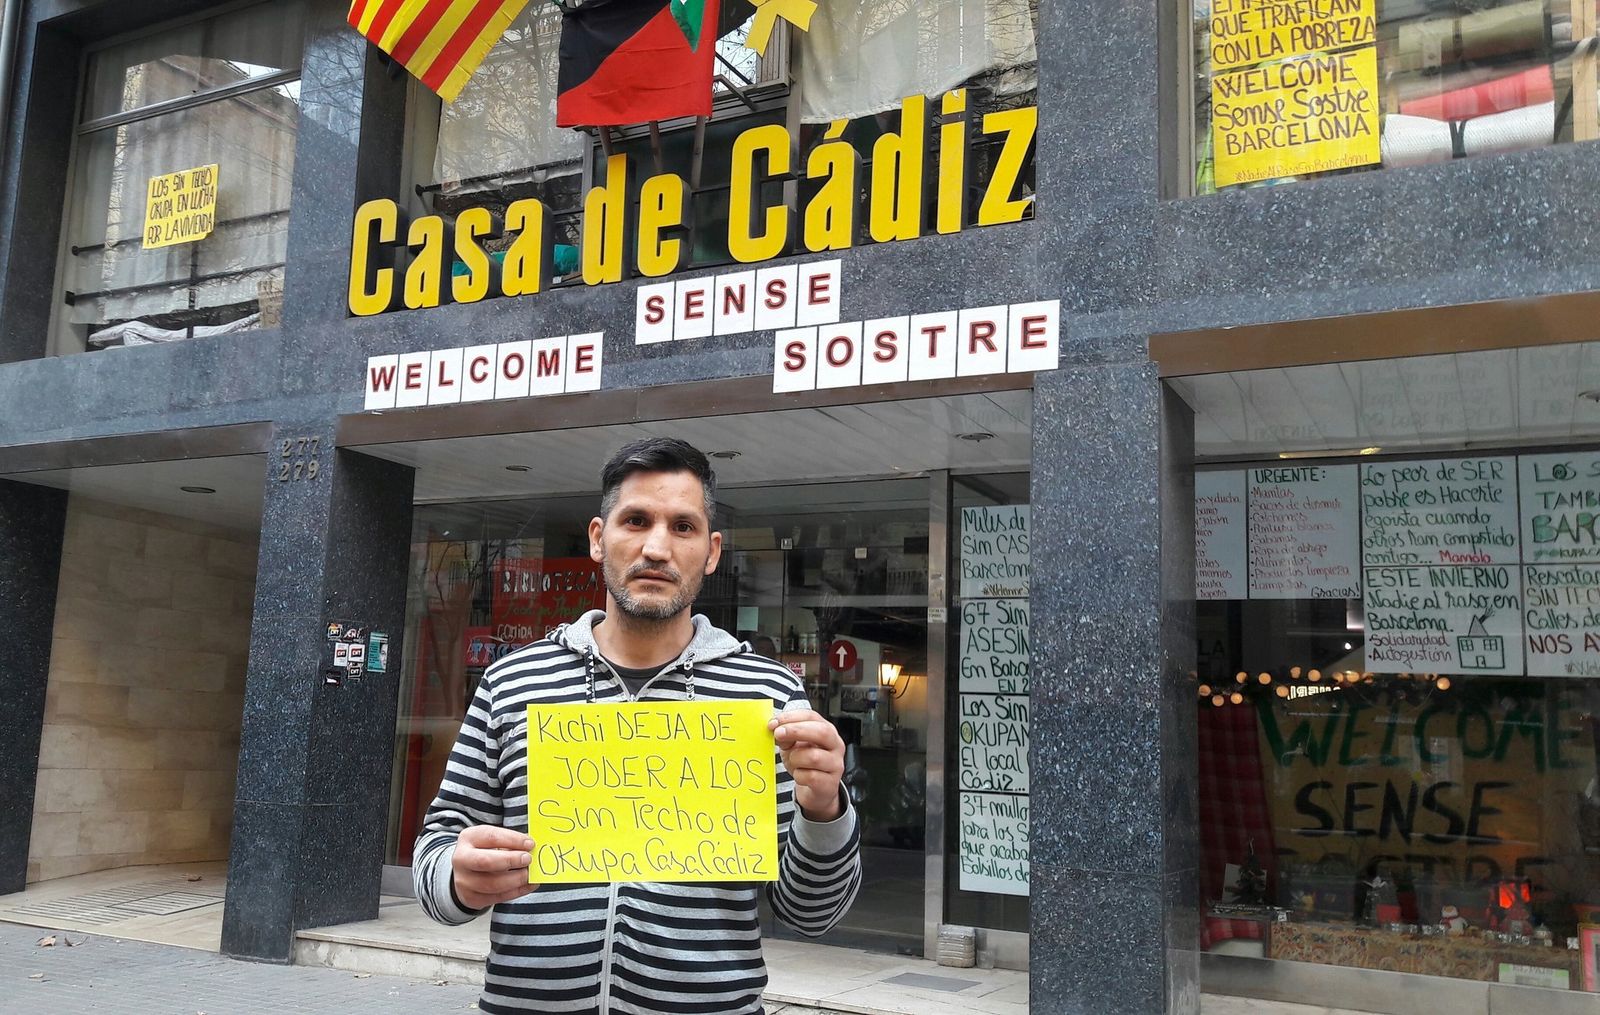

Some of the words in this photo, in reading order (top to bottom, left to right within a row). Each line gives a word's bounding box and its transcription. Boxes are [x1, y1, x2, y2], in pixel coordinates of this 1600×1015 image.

[1212, 11, 1252, 40] QUE
[1255, 0, 1361, 30] TRAFICAN
[1213, 39, 1251, 65] CON
[1256, 32, 1284, 58] LA
[1291, 16, 1376, 52] POBREZA
[1214, 53, 1357, 99] WELCOME
[1214, 98, 1286, 132] Sense
[1292, 86, 1369, 120] Sostre
[1226, 114, 1370, 155] BARCELONA
[152, 179, 169, 198] LOS
[177, 194, 189, 212] EN
[190, 185, 214, 210] LUCHA
[348, 198, 543, 316] Casa
[582, 153, 684, 286] de
[728, 88, 1038, 263] Cádiz
[147, 225, 162, 244] POR
[644, 273, 831, 325] SENSE
[783, 315, 1047, 372] SOSTRE
[371, 344, 594, 392] WELCOME
[282, 435, 320, 457] 277
[279, 460, 320, 482] 279
[1362, 465, 1385, 486] Lo
[1392, 465, 1430, 493] peor
[1436, 462, 1457, 481] de
[1461, 461, 1504, 481] SER
[1286, 499, 1297, 510] de
[1363, 489, 1410, 514] pobre
[1414, 491, 1437, 504] es
[1009, 506, 1026, 532] de
[1365, 568, 1421, 588] ESTE
[1428, 566, 1509, 589] INVIERNO
[1367, 589, 1419, 611] Nadie
[1423, 590, 1442, 610] al
[1493, 592, 1520, 610] en
[1527, 587, 1559, 607] SIN
[963, 602, 990, 625] 67
[1527, 609, 1578, 630] Calles
[1529, 634, 1573, 654] NOS
[998, 679, 1016, 693] EN
[962, 696, 991, 717] Los
[537, 711, 605, 744] Kichi
[616, 711, 691, 741] DEJA
[700, 712, 736, 741] DE
[1256, 696, 1591, 774] WELCOME
[961, 746, 978, 769] El
[985, 747, 1024, 774] local
[553, 755, 668, 790] JODER
[679, 757, 699, 789] A
[709, 756, 767, 794] LOS
[614, 795, 714, 834] Techo
[722, 798, 757, 840] de
[963, 795, 988, 817] 37
[1293, 779, 1519, 846] SENSE
[993, 819, 1014, 842] los
